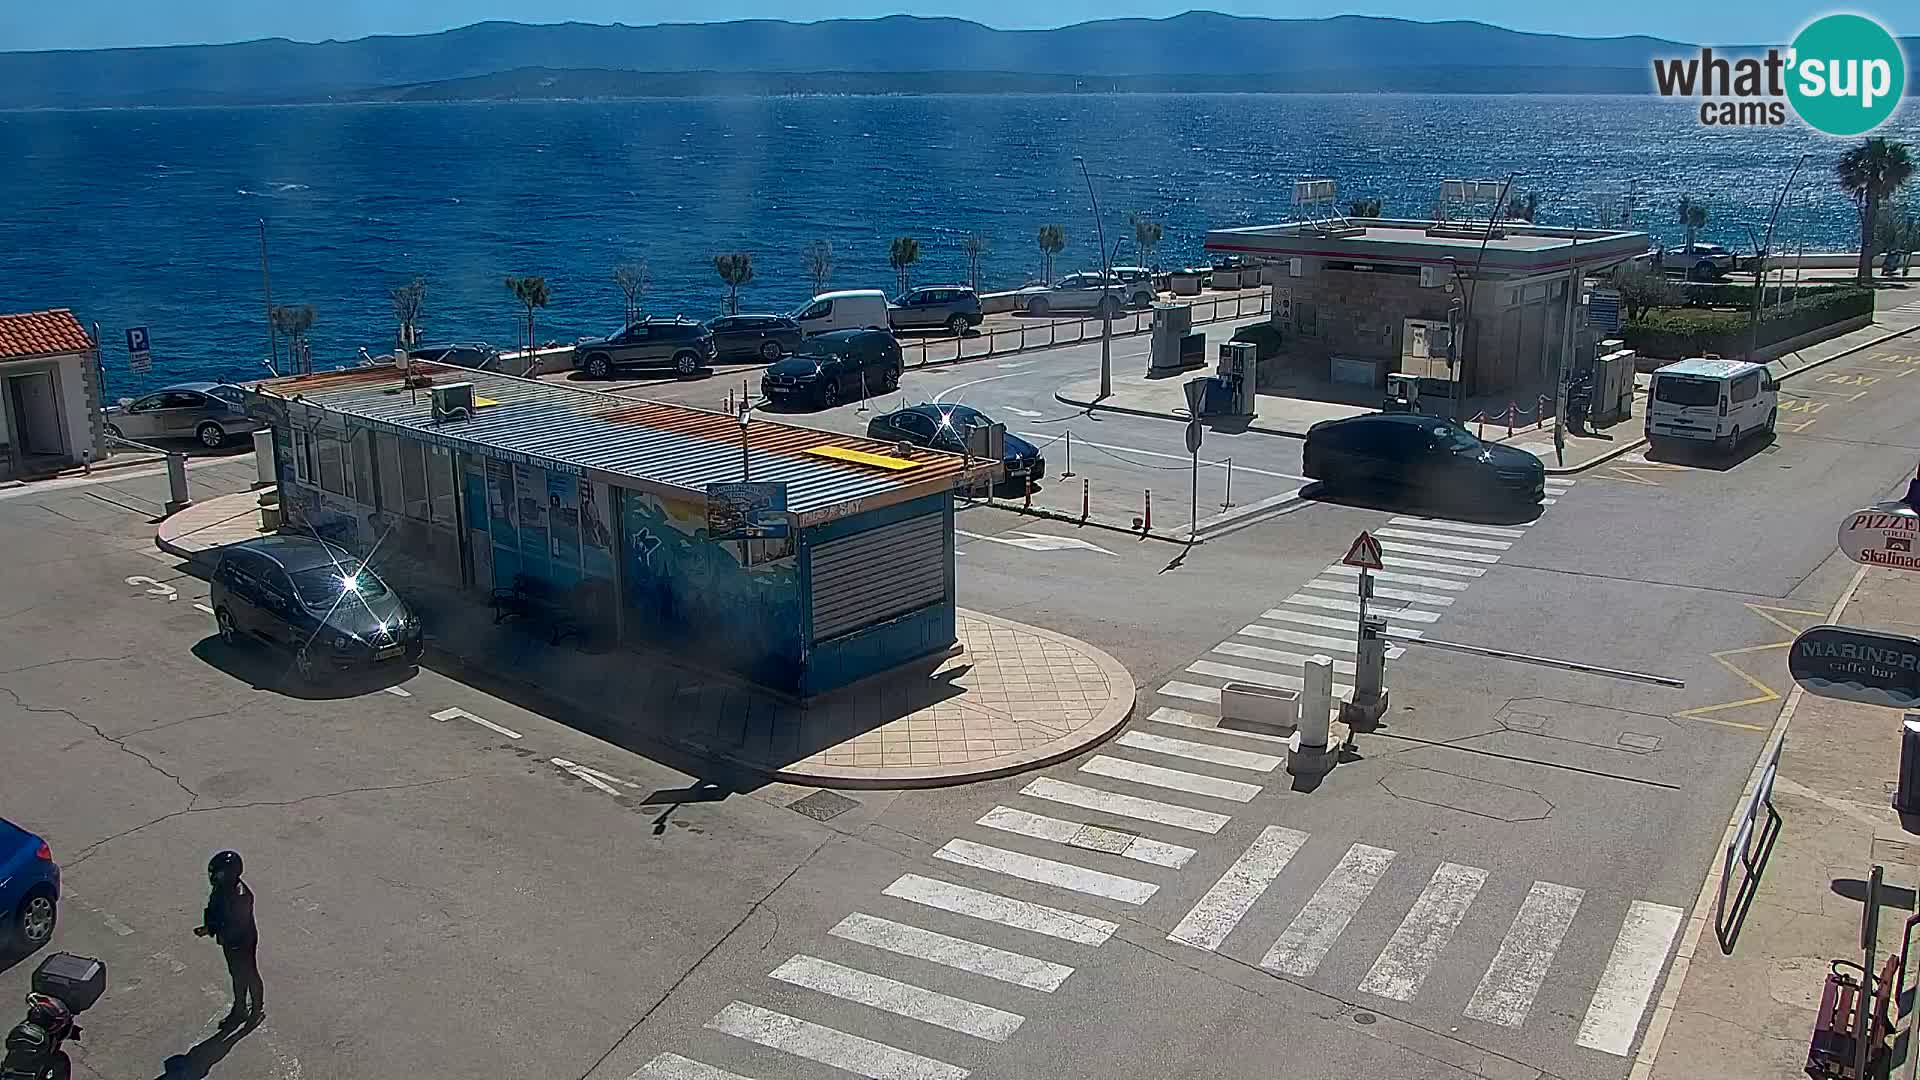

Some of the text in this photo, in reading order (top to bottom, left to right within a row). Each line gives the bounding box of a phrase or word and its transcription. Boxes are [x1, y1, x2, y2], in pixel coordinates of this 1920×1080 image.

[131, 330, 144, 349] P
[1816, 373, 1881, 387] TAXI
[1778, 399, 1830, 414] AXI
[495, 448, 527, 464] STATION
[529, 456, 555, 470] TICKET
[556, 462, 583, 476] OFFICE
[1848, 514, 1920, 532] PIZZE
[1871, 664, 1897, 680] bar
